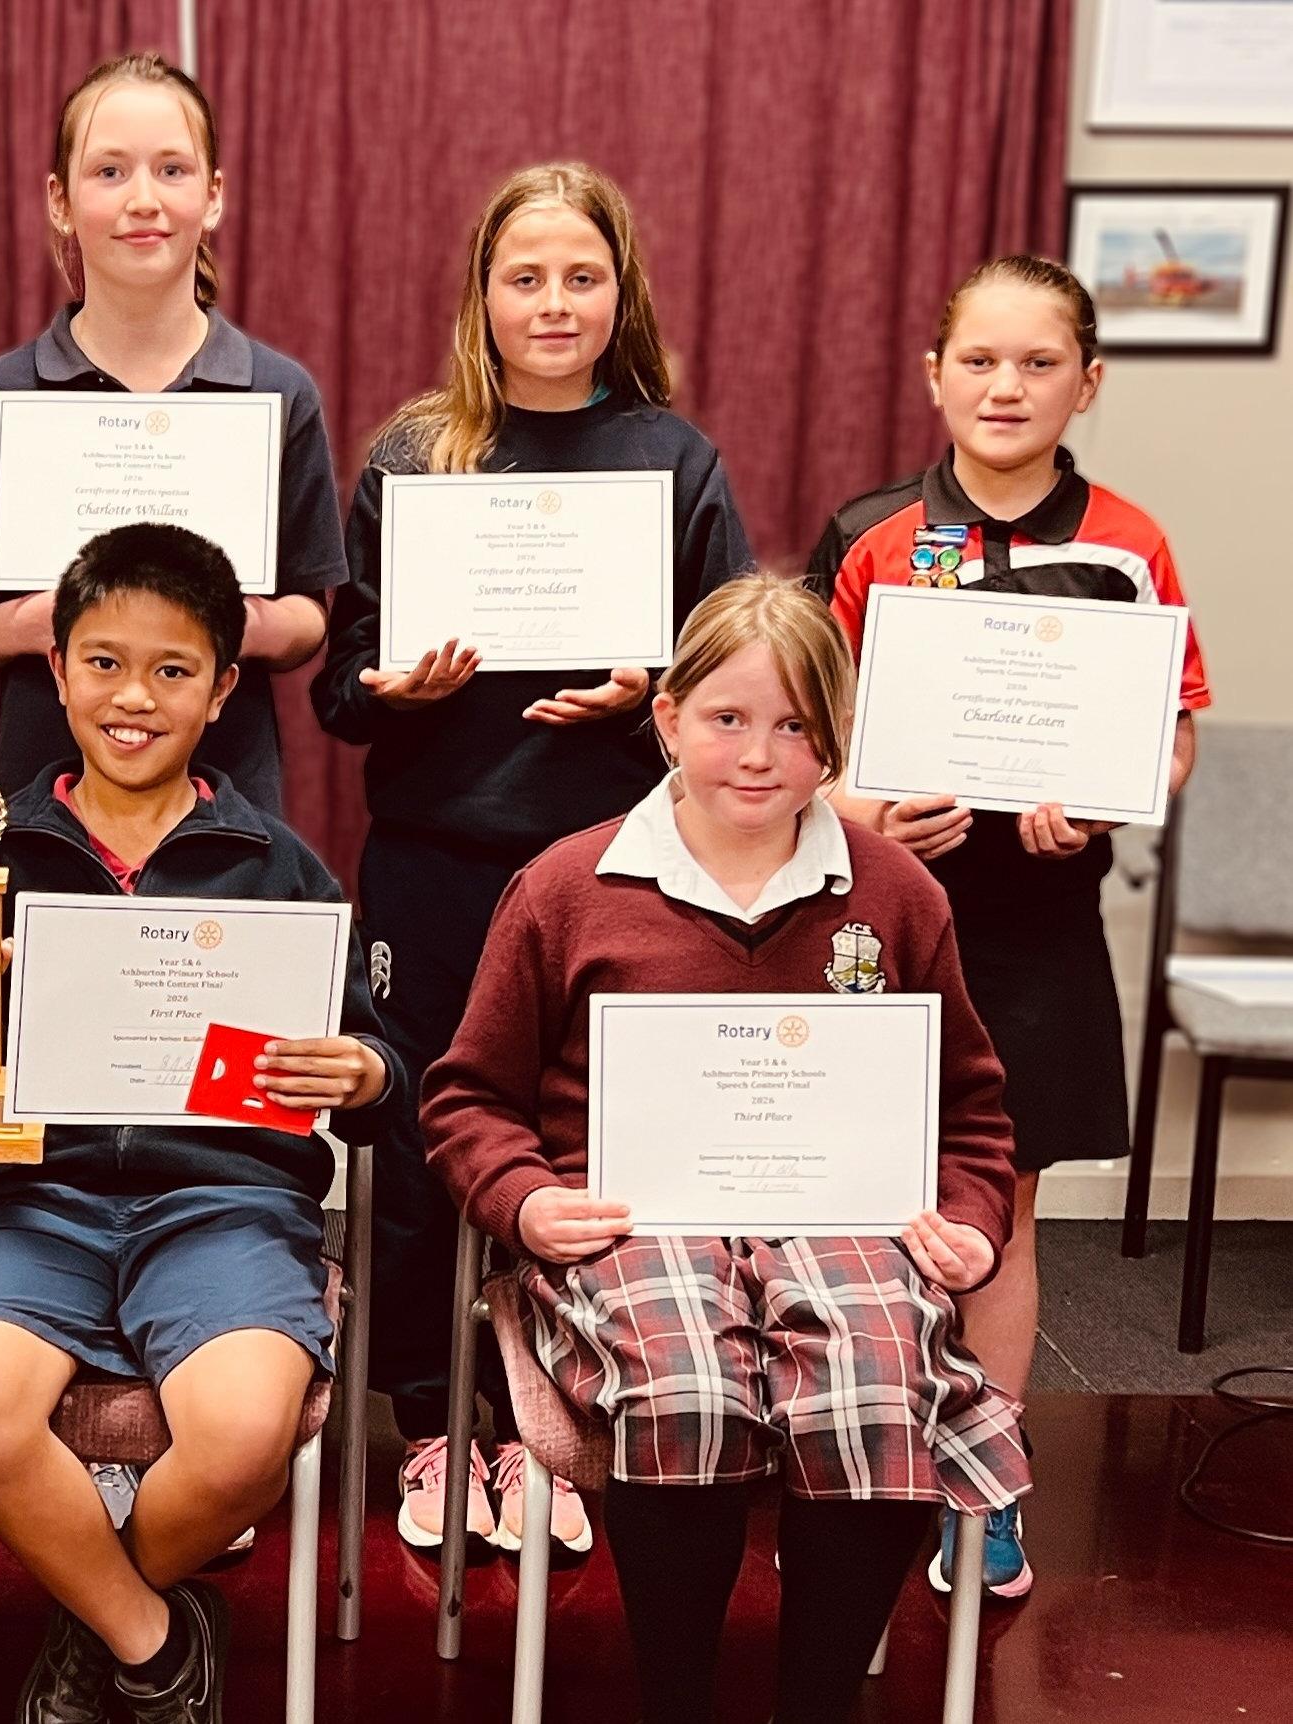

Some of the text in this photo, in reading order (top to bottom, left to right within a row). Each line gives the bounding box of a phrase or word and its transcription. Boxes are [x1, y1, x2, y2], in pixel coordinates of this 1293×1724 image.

[99, 416, 140, 430] Rotary
[75, 487, 189, 497] Certificate of Participation
[77, 503, 188, 517] Charlotte Whillans
[490, 497, 532, 510] Rotary
[469, 568, 513, 576] Certificate
[475, 582, 577, 596] Summer Stoddart
[984, 618, 1030, 634] Rotary
[952, 693, 1078, 710] Certificate of Participation
[963, 708, 1065, 728] Charlotte Loten
[141, 926, 189, 942] Rotary
[842, 923, 872, 936] ACS
[169, 969, 203, 978] Primary
[206, 970, 239, 978] Schools
[134, 979, 164, 988] Speech
[150, 1009, 202, 1018] First Place
[718, 1024, 771, 1040] Rotary
[752, 1071, 788, 1079] Primary
[717, 1082, 748, 1090] Speech
[788, 1081, 810, 1089] Final
[734, 1112, 793, 1121] Third Place
